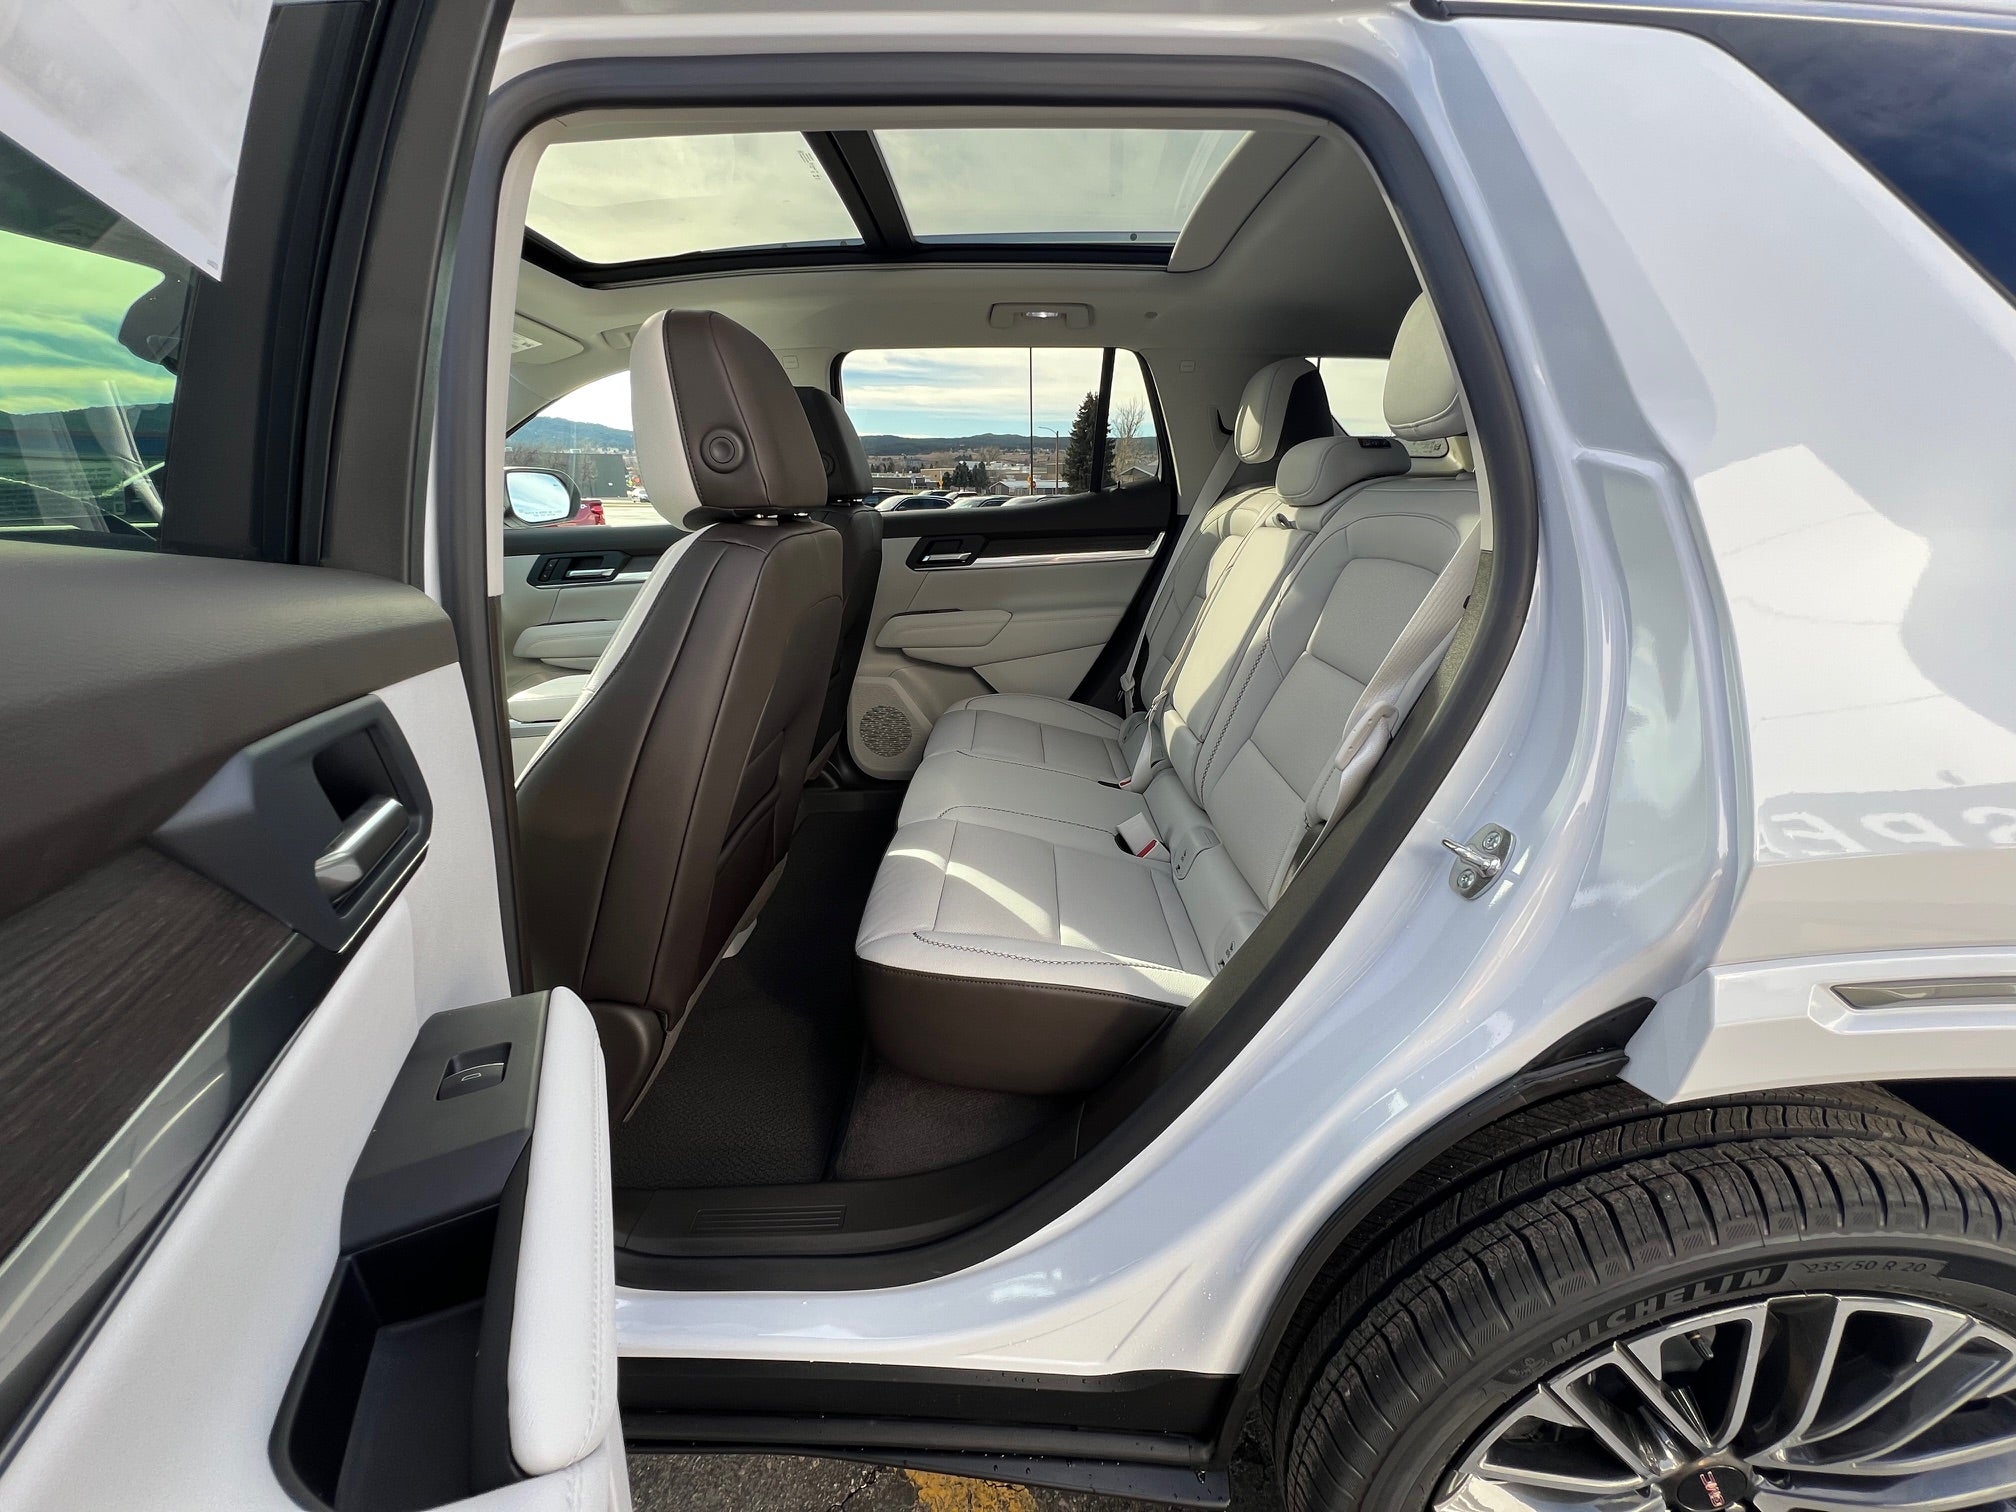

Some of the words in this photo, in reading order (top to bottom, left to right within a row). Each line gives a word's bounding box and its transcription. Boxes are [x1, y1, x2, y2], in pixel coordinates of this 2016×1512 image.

[1807, 1260, 1879, 1274] 235/50
[1882, 1260, 1898, 1271] R
[1901, 1262, 1928, 1273] 20
[1551, 1267, 1772, 1357] MICHELIN
